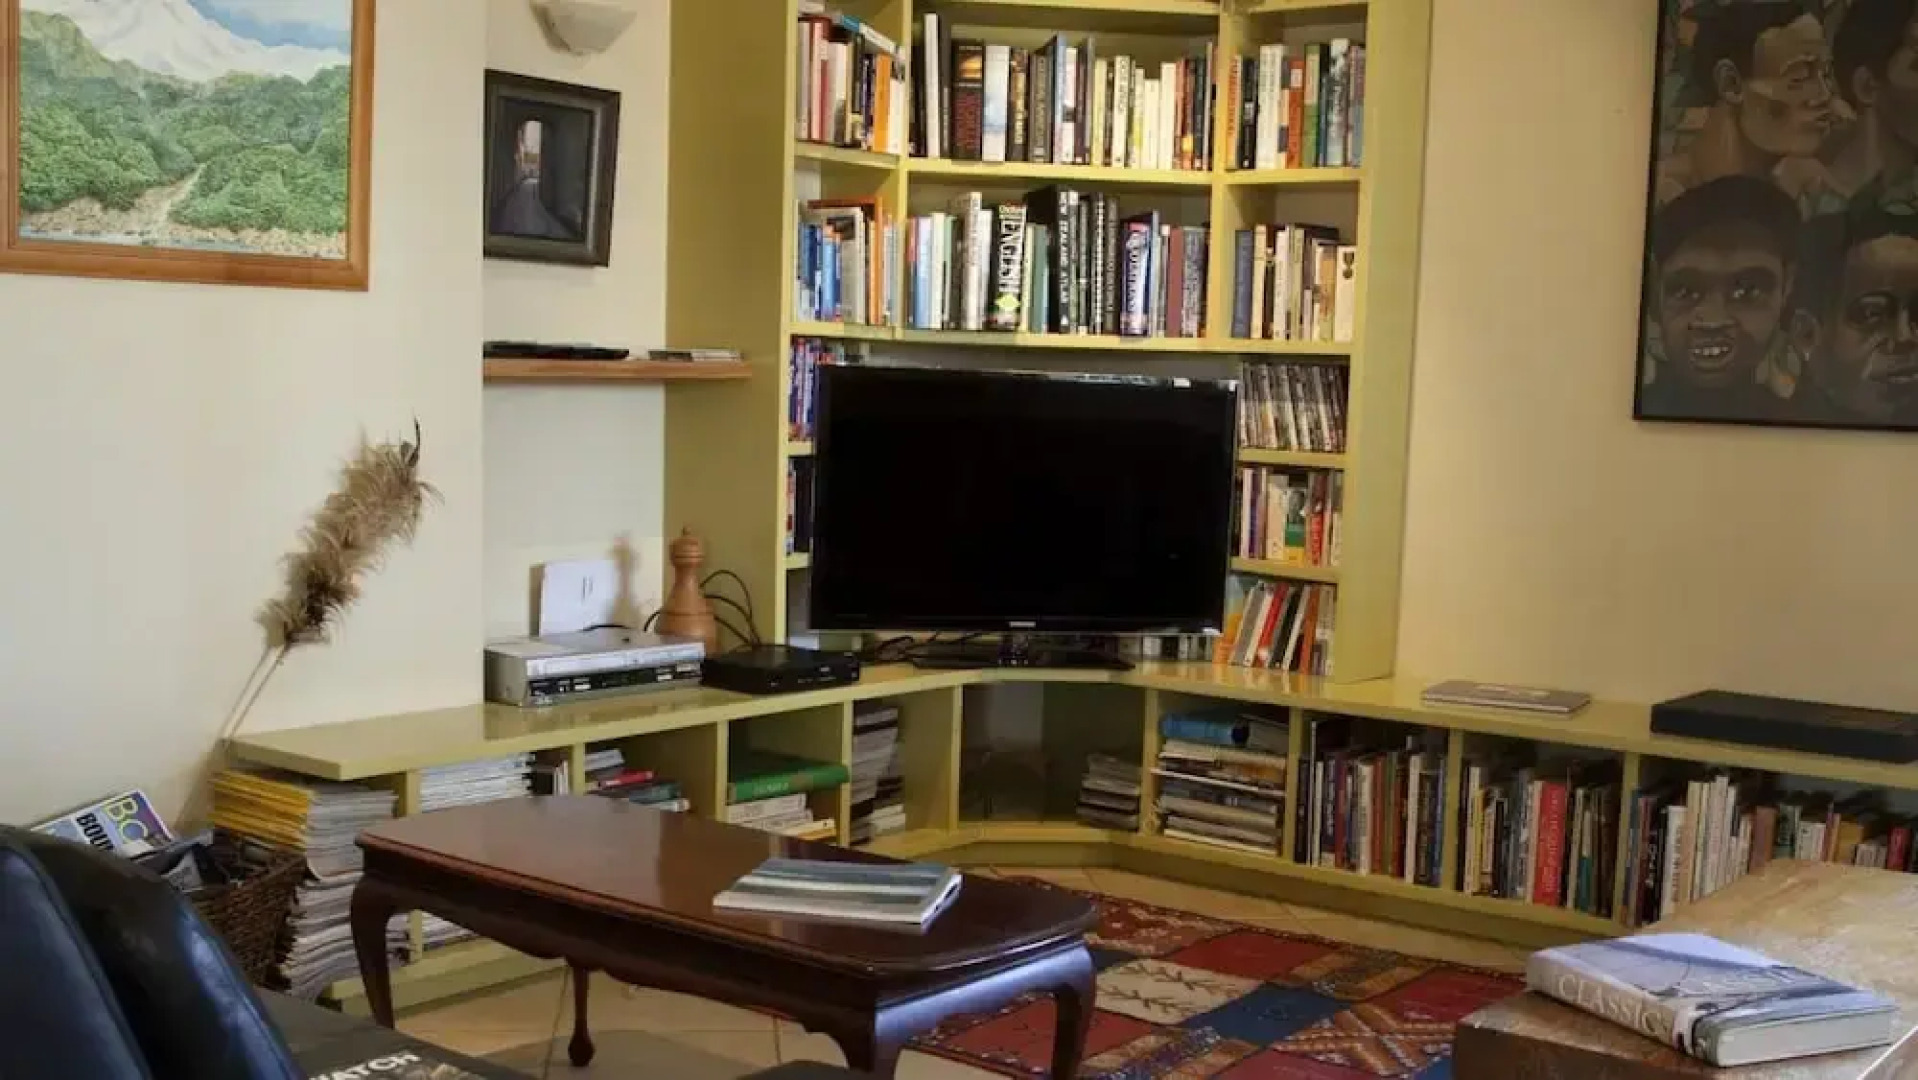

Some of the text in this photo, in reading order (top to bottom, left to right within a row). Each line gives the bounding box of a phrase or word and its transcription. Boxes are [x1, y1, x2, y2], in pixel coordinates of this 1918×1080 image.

[998, 219, 1025, 293] ENGLISH
[1558, 974, 1670, 1038] CLASSICS
[310, 1051, 421, 1080] ATCH
